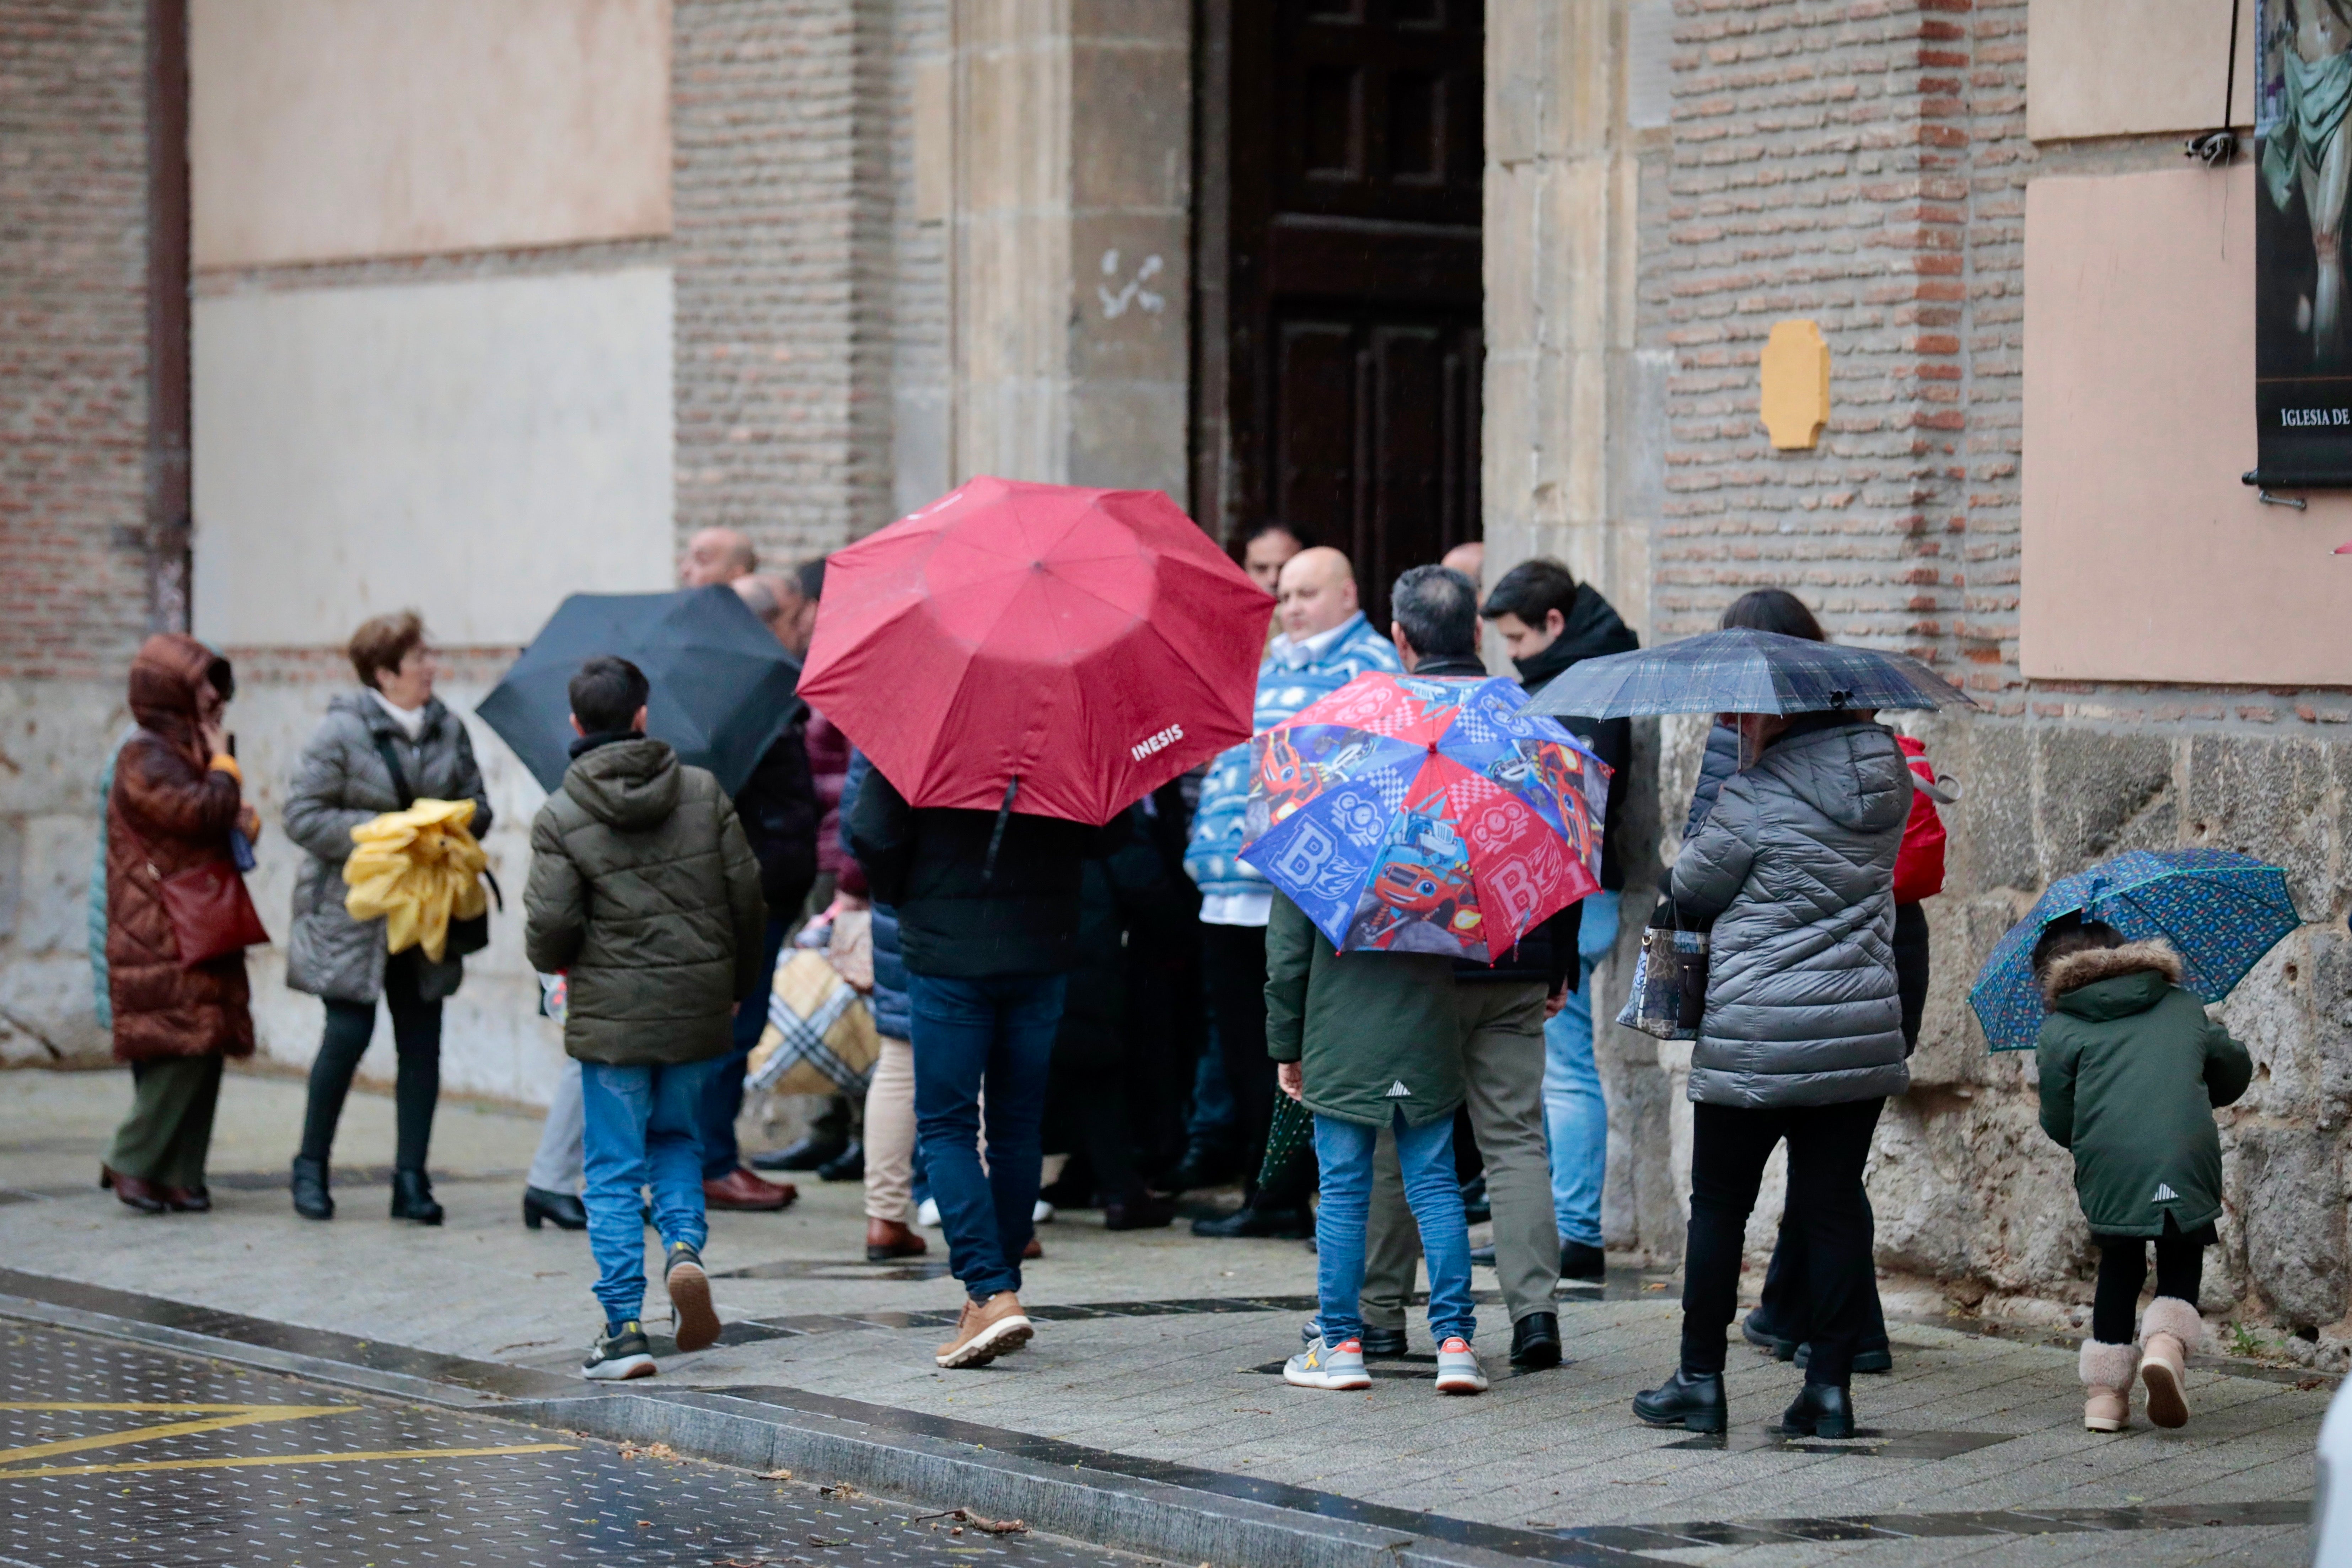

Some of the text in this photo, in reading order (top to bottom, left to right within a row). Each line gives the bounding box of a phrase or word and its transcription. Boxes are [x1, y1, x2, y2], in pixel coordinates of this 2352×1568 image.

[2281, 408, 2350, 426] IGLESIA DE
[1131, 724, 1183, 761] INESIS
[1273, 819, 1335, 887] B
